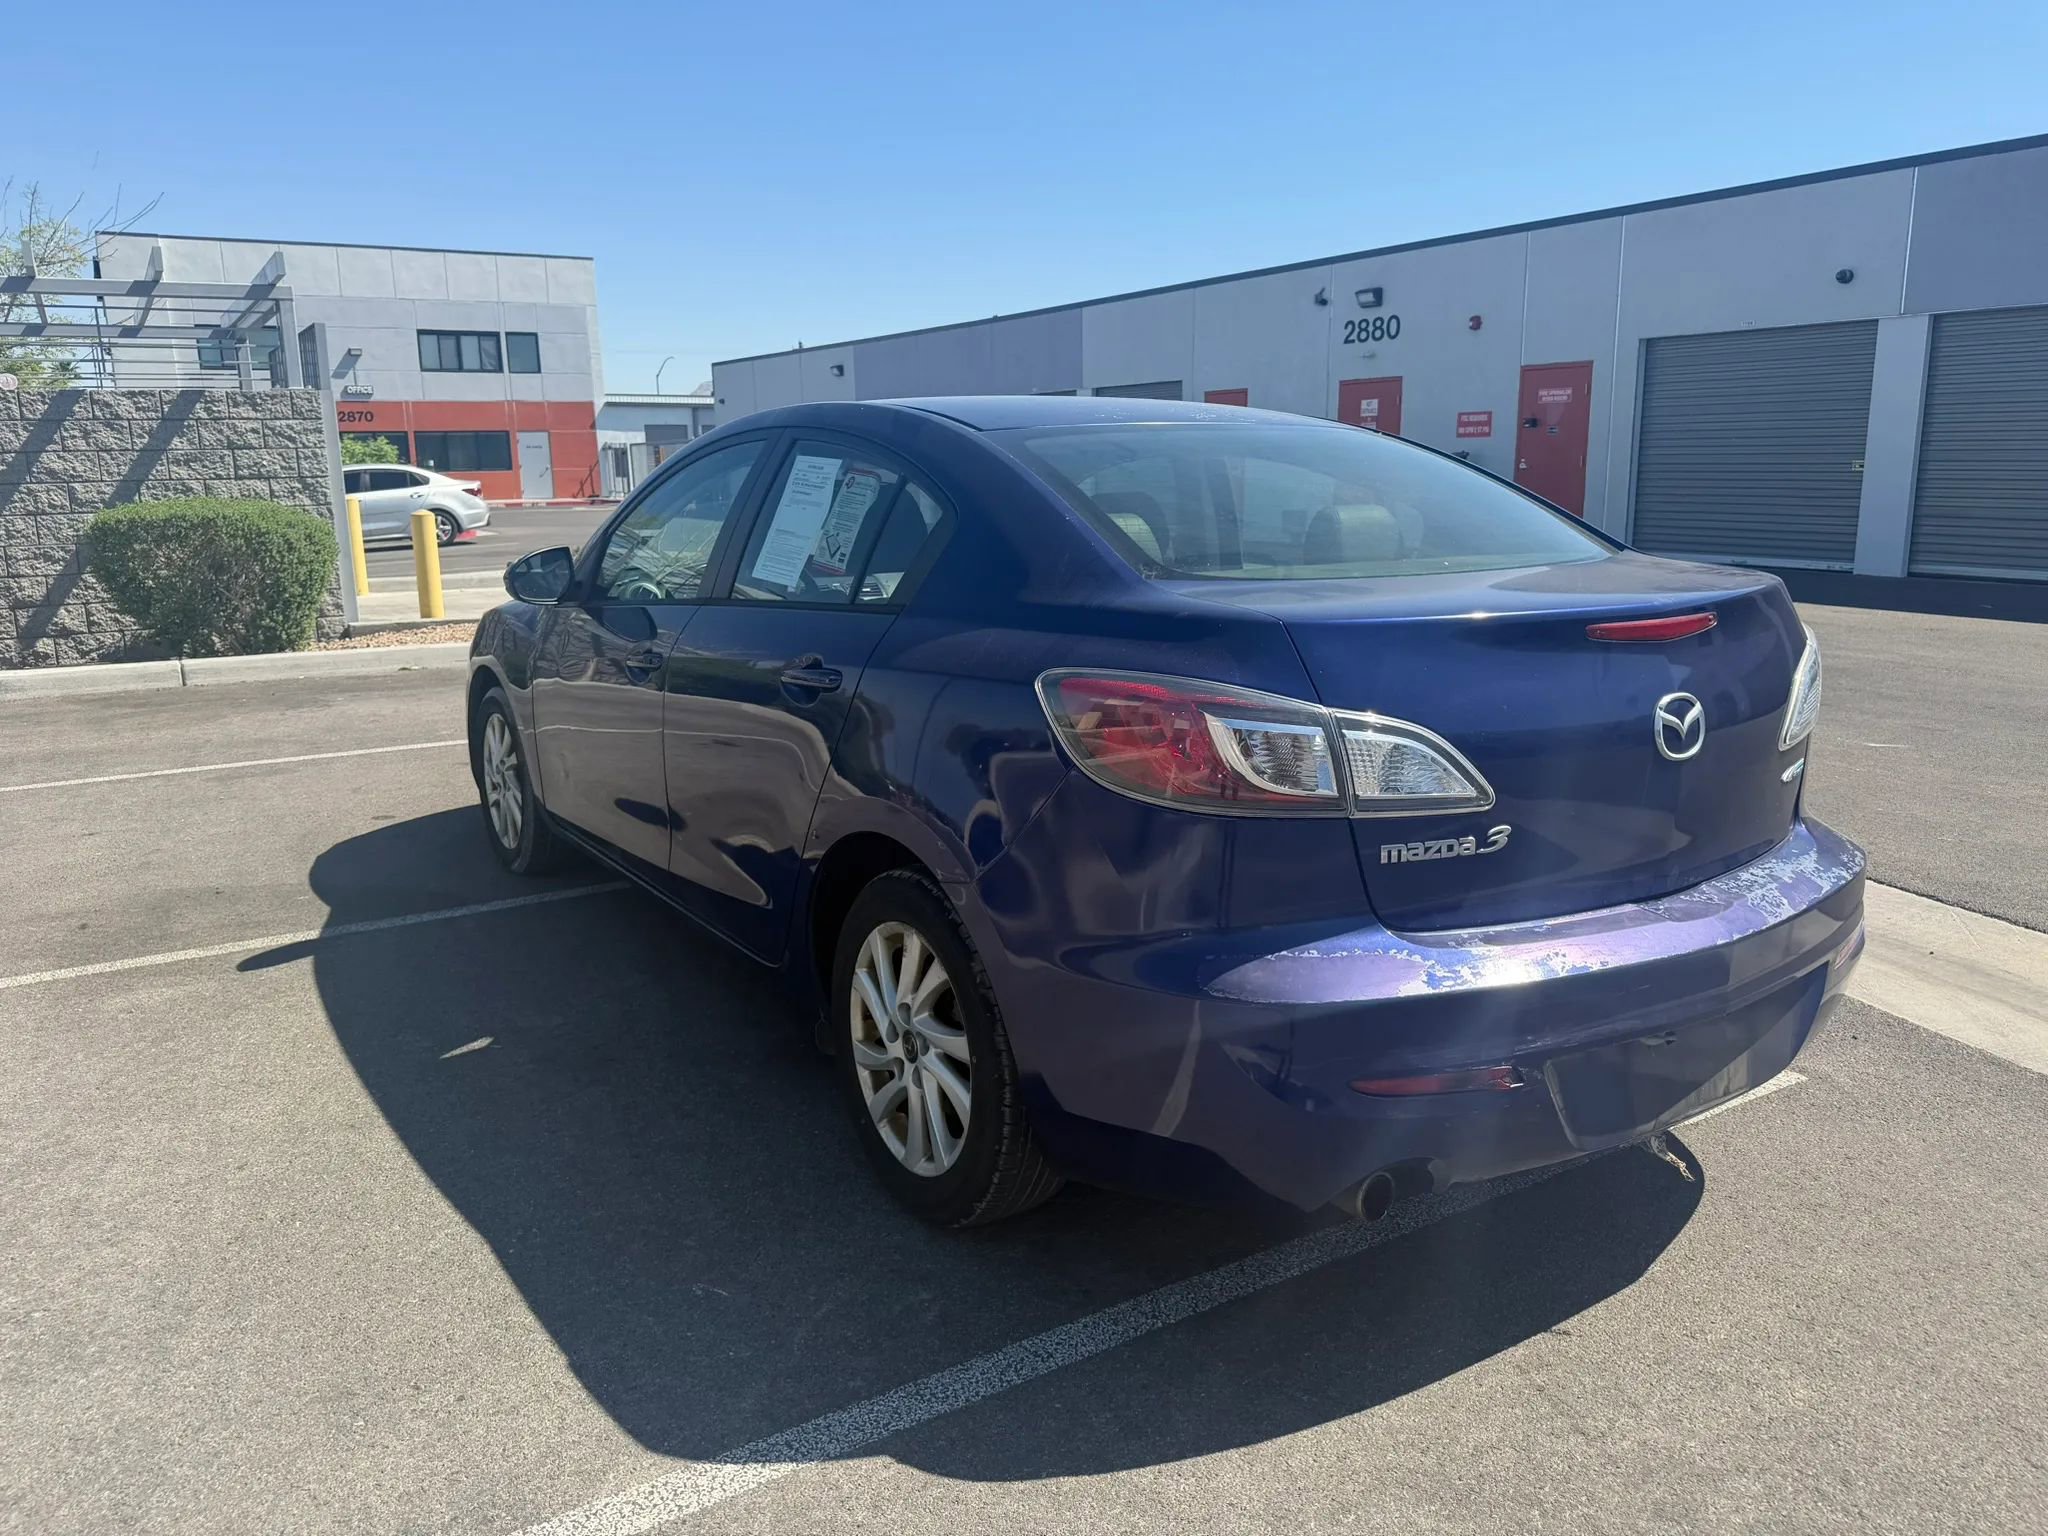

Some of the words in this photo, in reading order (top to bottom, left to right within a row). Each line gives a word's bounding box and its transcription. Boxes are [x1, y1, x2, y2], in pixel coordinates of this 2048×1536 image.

[1343, 314, 1401, 344] 2880
[347, 386, 373, 394] OFFICE
[338, 411, 374, 423] 2870
